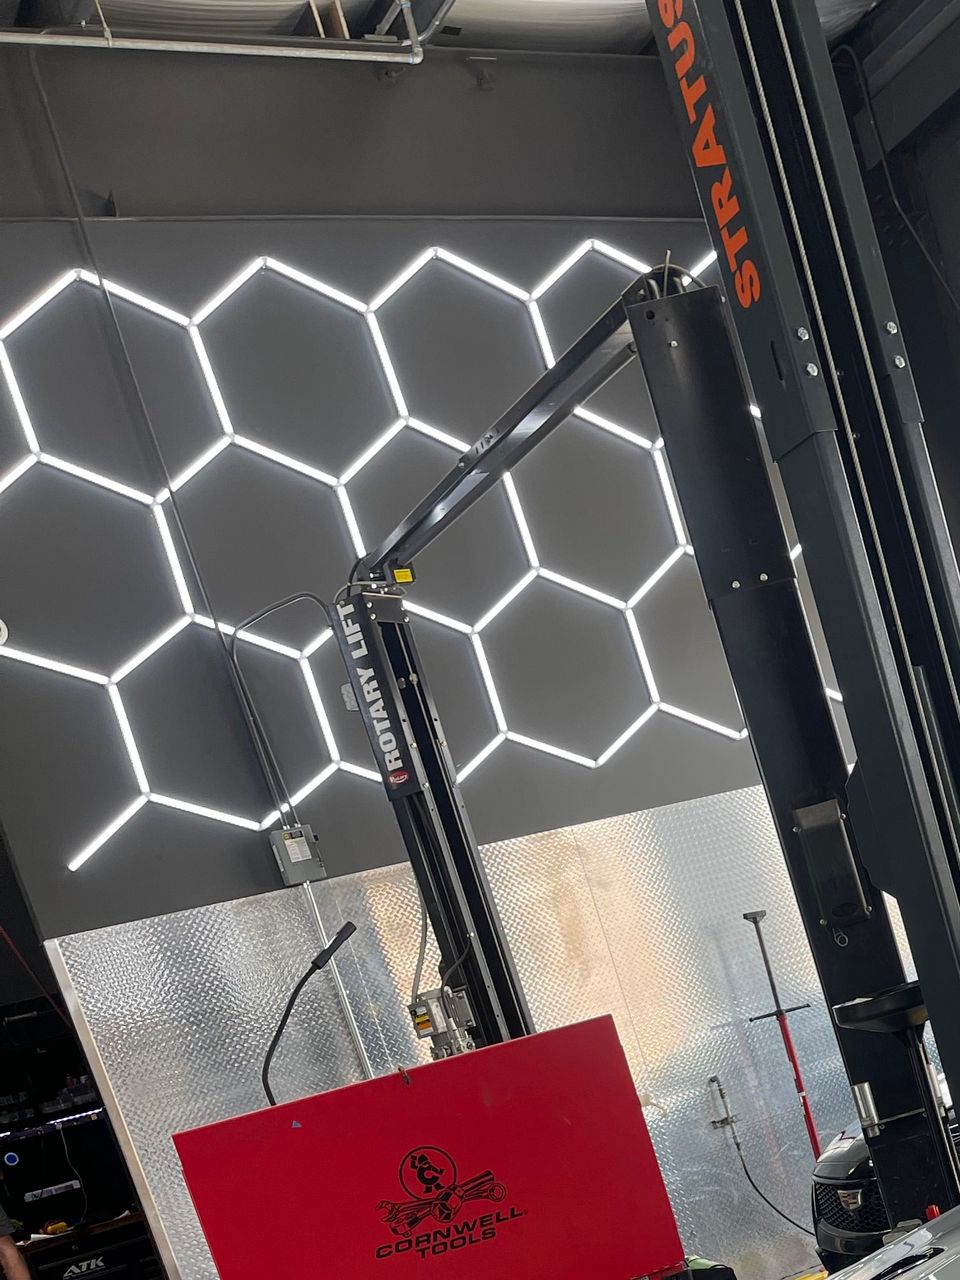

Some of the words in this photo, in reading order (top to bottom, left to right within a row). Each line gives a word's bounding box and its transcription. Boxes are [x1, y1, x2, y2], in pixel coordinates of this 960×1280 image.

[336, 603, 369, 660] LIFT
[356, 667, 404, 772] ROTARY
[375, 1207, 524, 1259] CORNWELL
[416, 1227, 497, 1259] TOOLS
[63, 1256, 106, 1279] ATK
